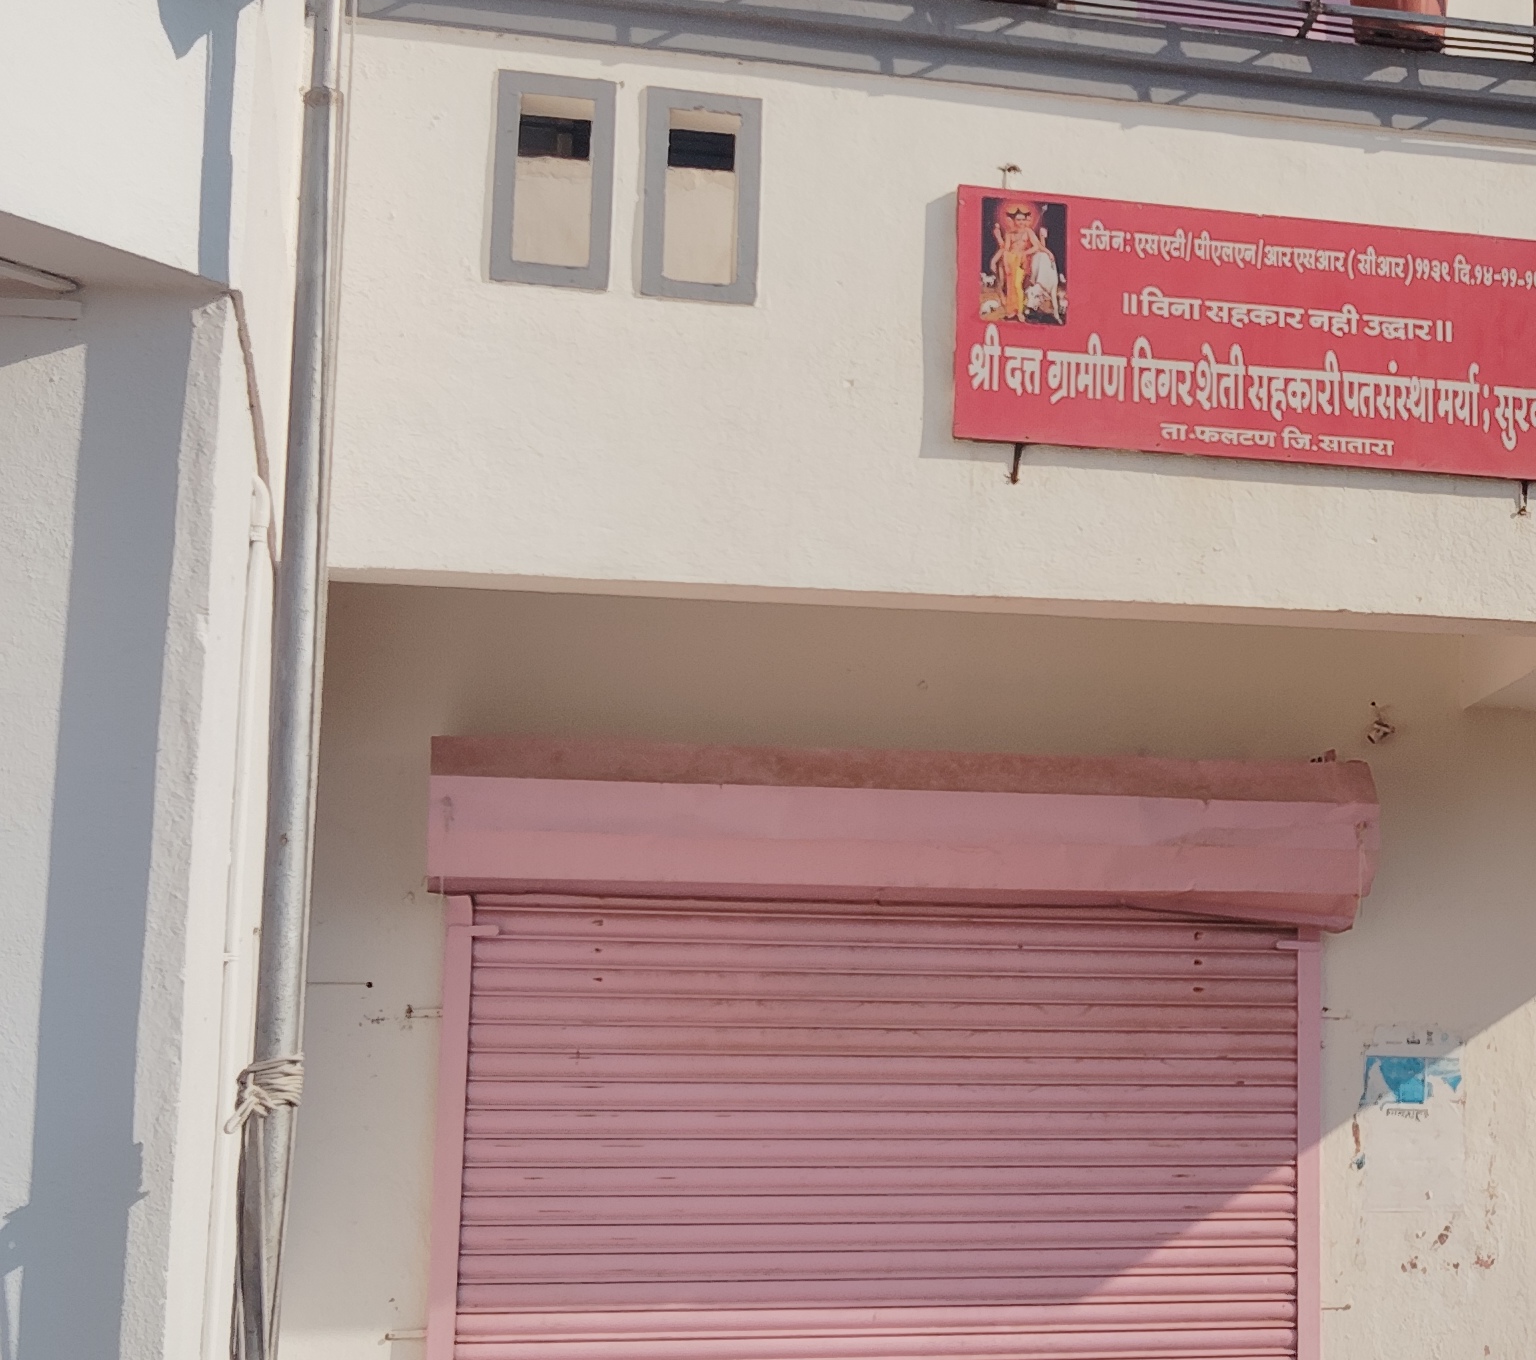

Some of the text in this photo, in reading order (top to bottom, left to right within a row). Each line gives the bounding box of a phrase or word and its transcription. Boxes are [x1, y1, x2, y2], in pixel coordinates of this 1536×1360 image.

[1205, 300, 1305, 330] सहकार
[1308, 303, 1360, 337] नही
[968, 323, 1001, 392] श्री
[1004, 346, 1044, 396] दत्त
[1047, 332, 1128, 405] ग्रामीण
[1131, 336, 1195, 407] बिगर
[1196, 343, 1246, 411] शेती
[1248, 349, 1341, 422] सहकारी
[1343, 359, 1436, 425] पतसंस्था
